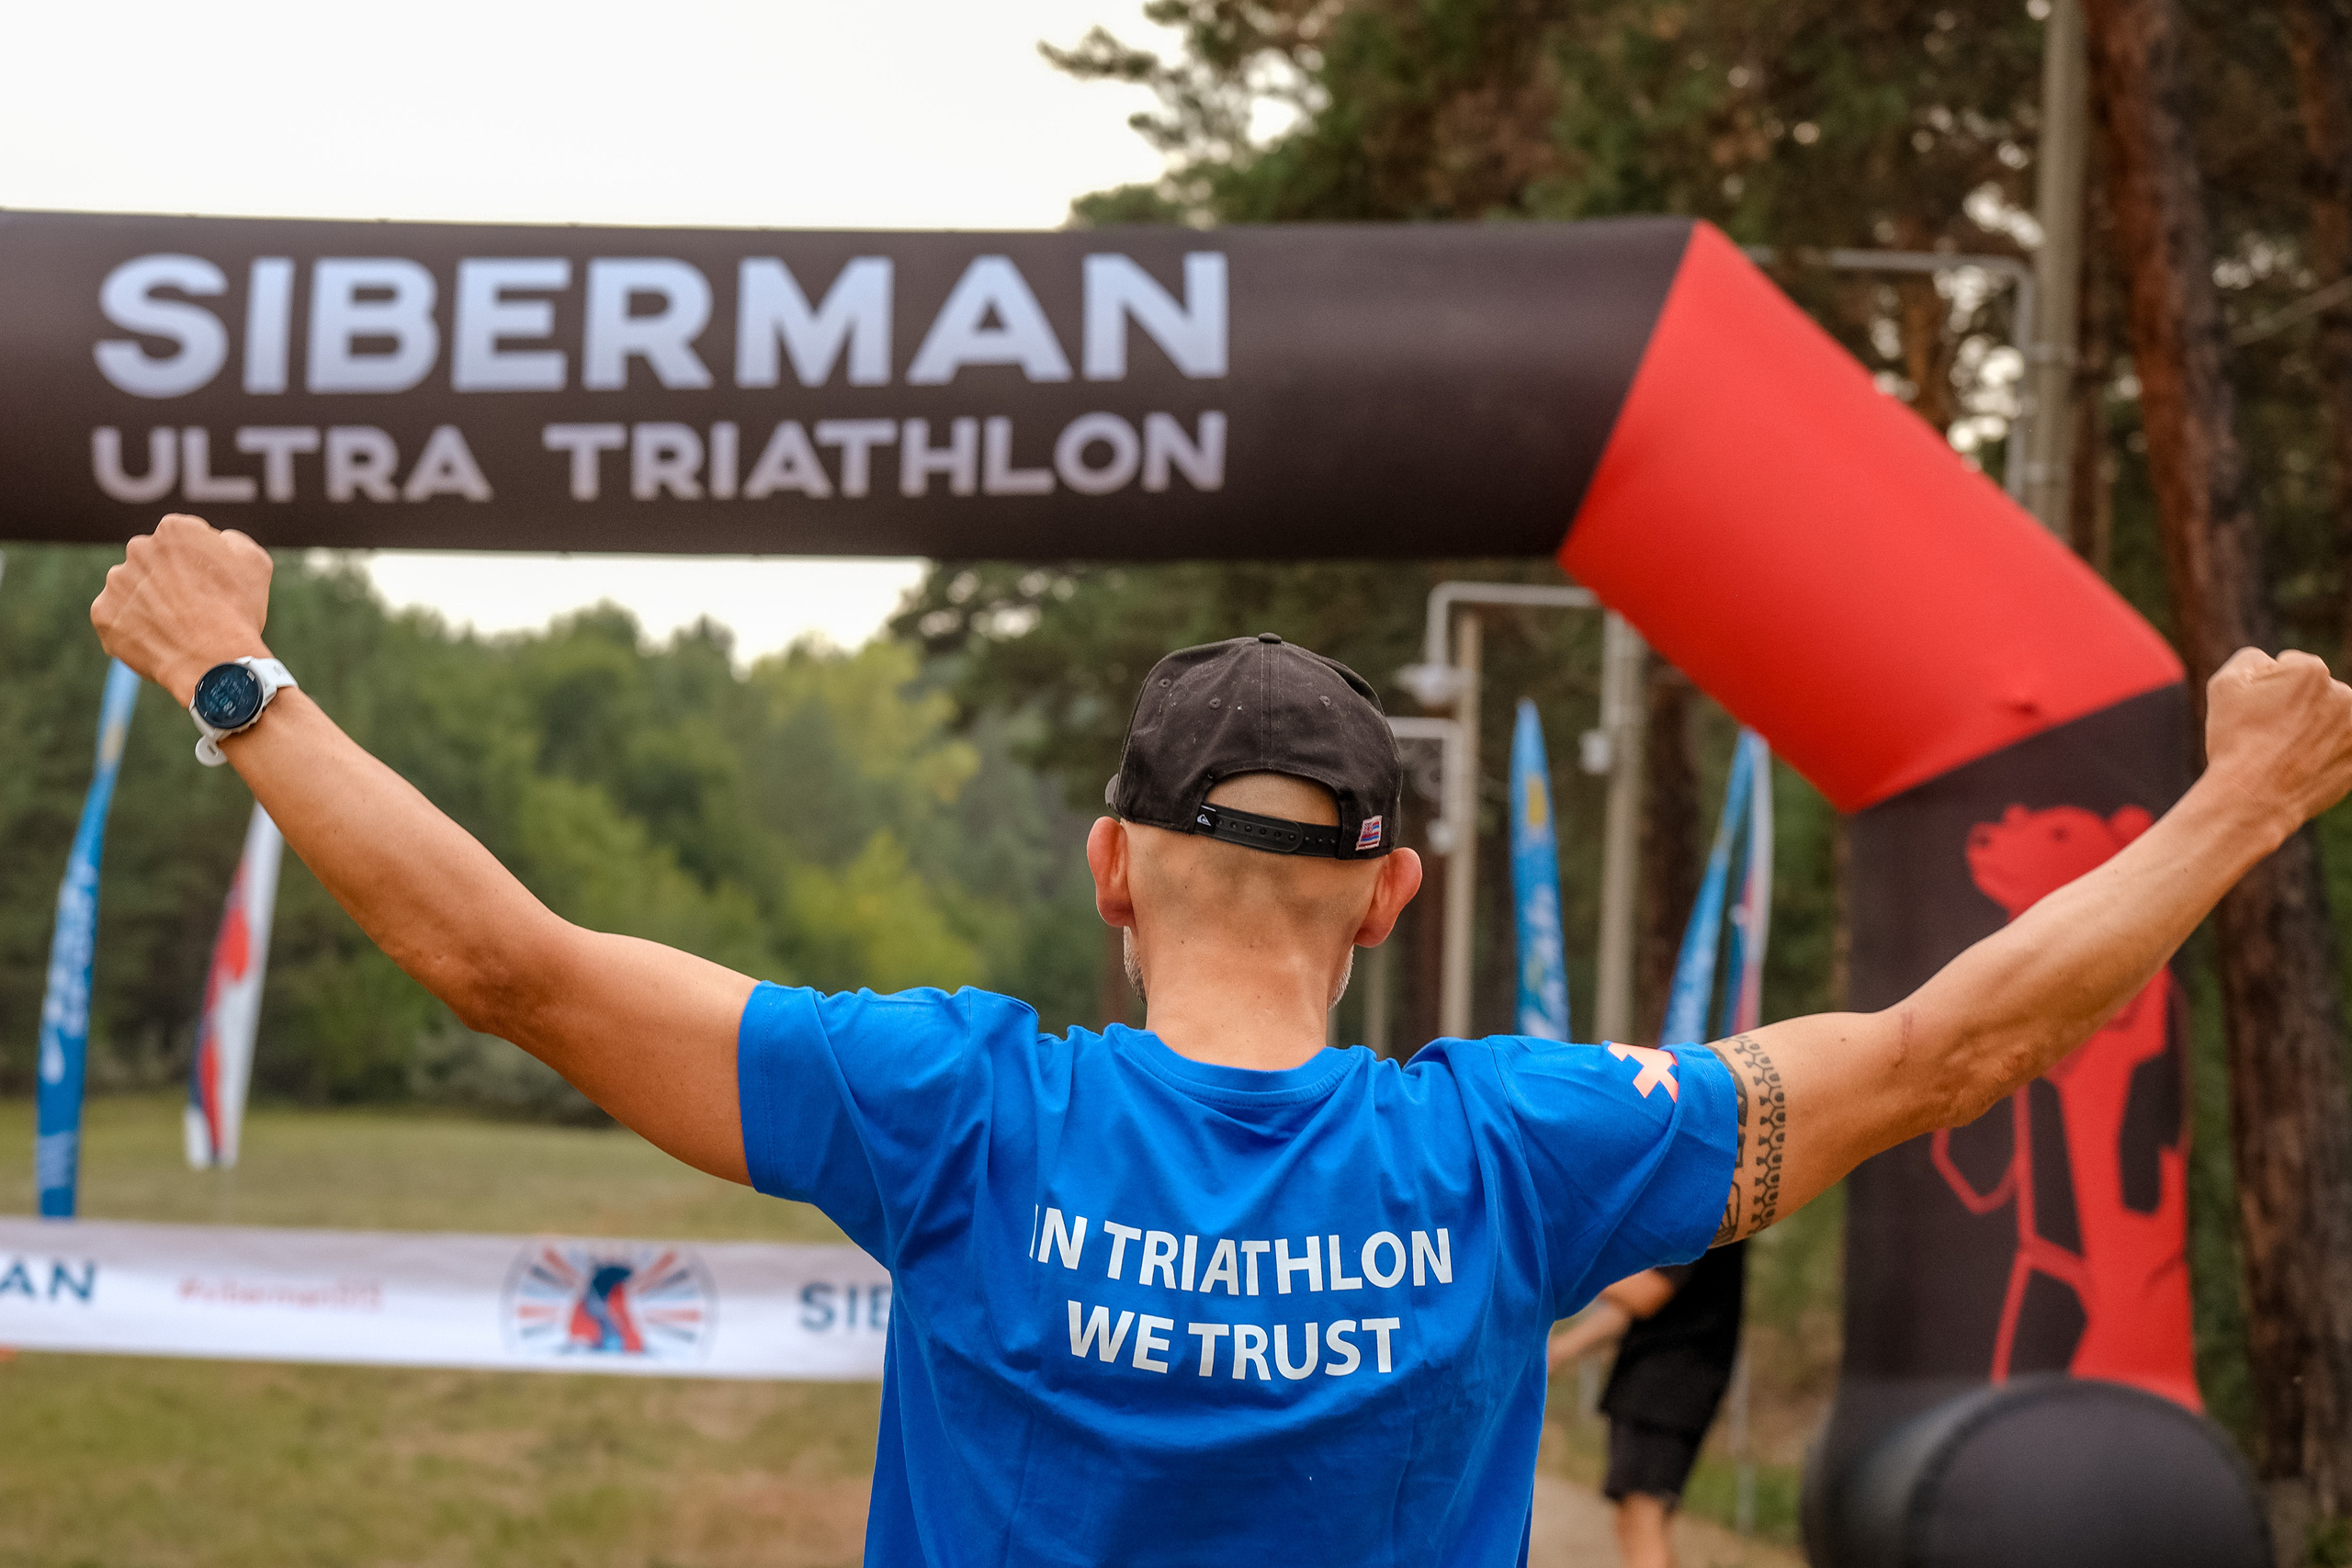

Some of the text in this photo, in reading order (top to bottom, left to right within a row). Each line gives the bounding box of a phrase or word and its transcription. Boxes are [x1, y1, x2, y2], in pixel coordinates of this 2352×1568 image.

[95, 252, 1229, 399] SIBERMAN
[91, 411, 1227, 503] ULTRA TRIATHLON
[1029, 1203, 1453, 1296] N TRIATHLON
[1068, 1300, 1401, 1381] WE TRUST
